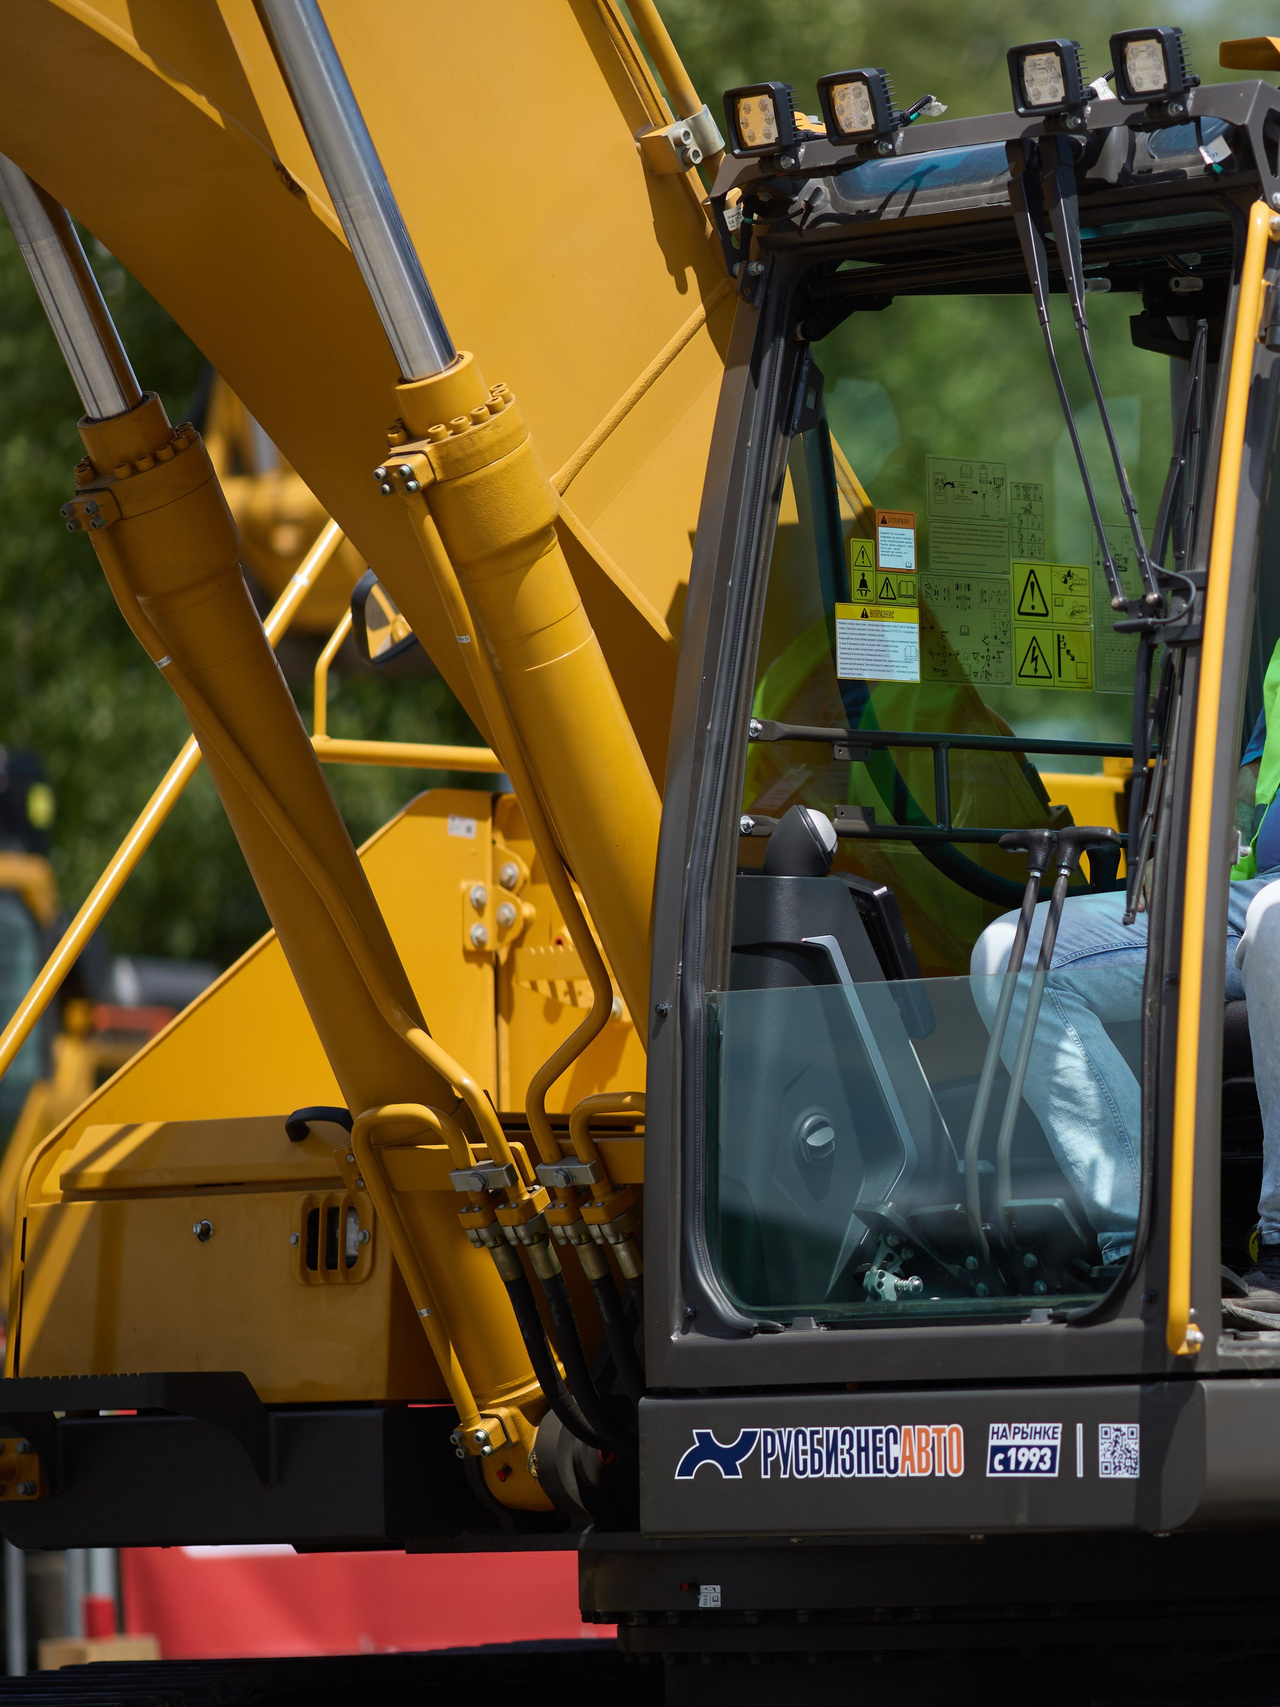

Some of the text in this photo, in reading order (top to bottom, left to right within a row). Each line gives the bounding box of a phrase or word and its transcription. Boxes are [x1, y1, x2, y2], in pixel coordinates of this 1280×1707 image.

[990, 1426, 1060, 1440] НА РЫНКЕ
[761, 1424, 964, 1478] РУСБИЗНЕСАВТО
[1007, 1446, 1052, 1471] 1993
